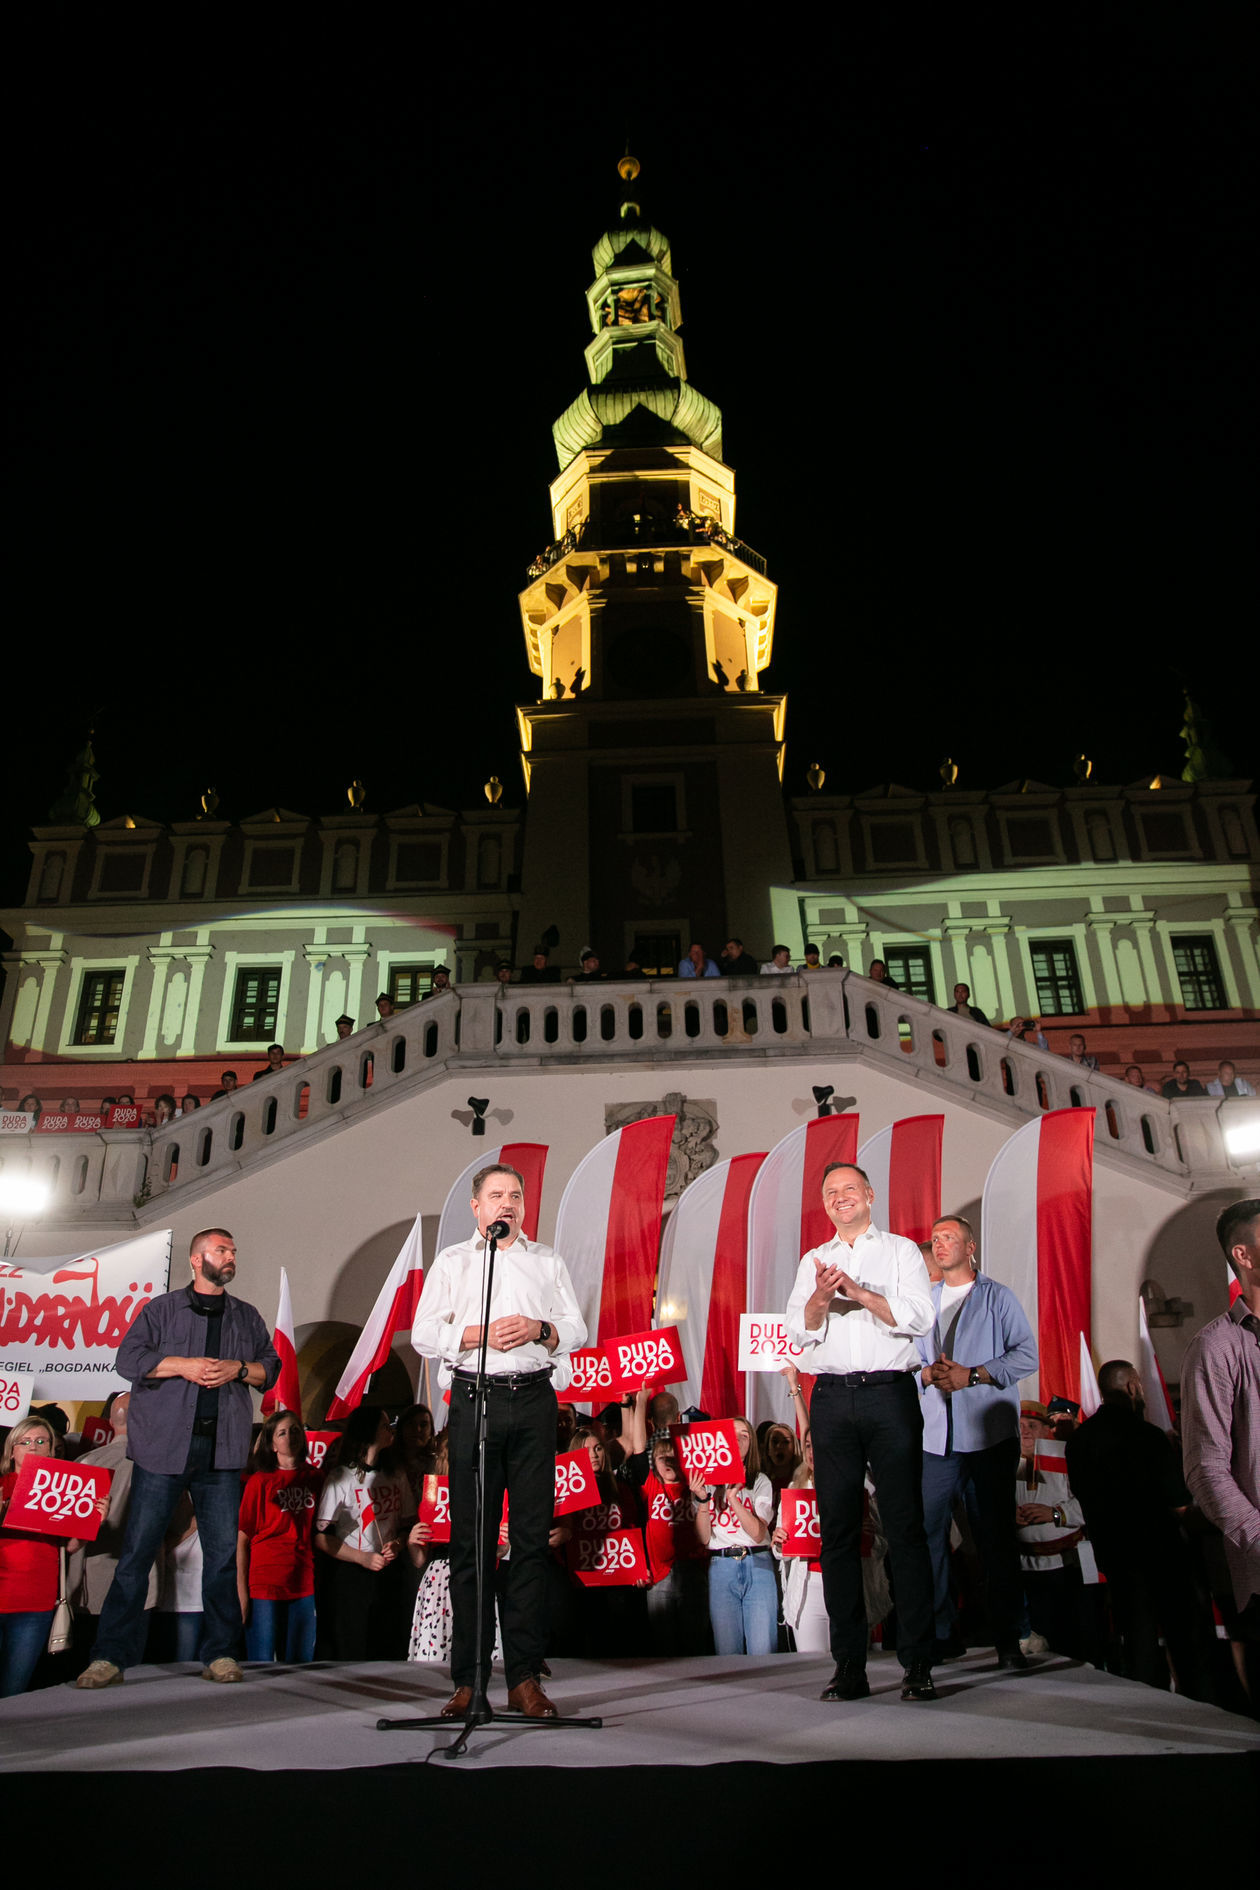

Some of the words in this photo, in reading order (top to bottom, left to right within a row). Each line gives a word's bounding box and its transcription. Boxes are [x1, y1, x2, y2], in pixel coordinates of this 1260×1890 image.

[2, 1115, 27, 1123] DUDA
[41, 1121, 68, 1129] 2020
[74, 1121, 101, 1129] 2020
[76, 1115, 101, 1123] DUDA
[112, 1114, 137, 1122] 2020
[750, 1323, 788, 1339] DUD
[618, 1338, 672, 1362] DUDA
[750, 1339, 804, 1356] 2020
[573, 1356, 610, 1372] UDA
[620, 1353, 674, 1378] 2020
[571, 1370, 612, 1387] 020
[681, 1431, 730, 1451] DUDA
[683, 1448, 732, 1469] 2020
[555, 1461, 583, 1482] DA
[33, 1469, 97, 1499] DUDA
[554, 1476, 586, 1497] 20
[24, 1488, 95, 1518] 2020
[796, 1500, 820, 1519] DU
[582, 1515, 621, 1531] 020
[709, 1512, 740, 1528] 202
[794, 1518, 822, 1538] 20
[579, 1537, 635, 1555] DUDA
[580, 1552, 637, 1570] 2020
